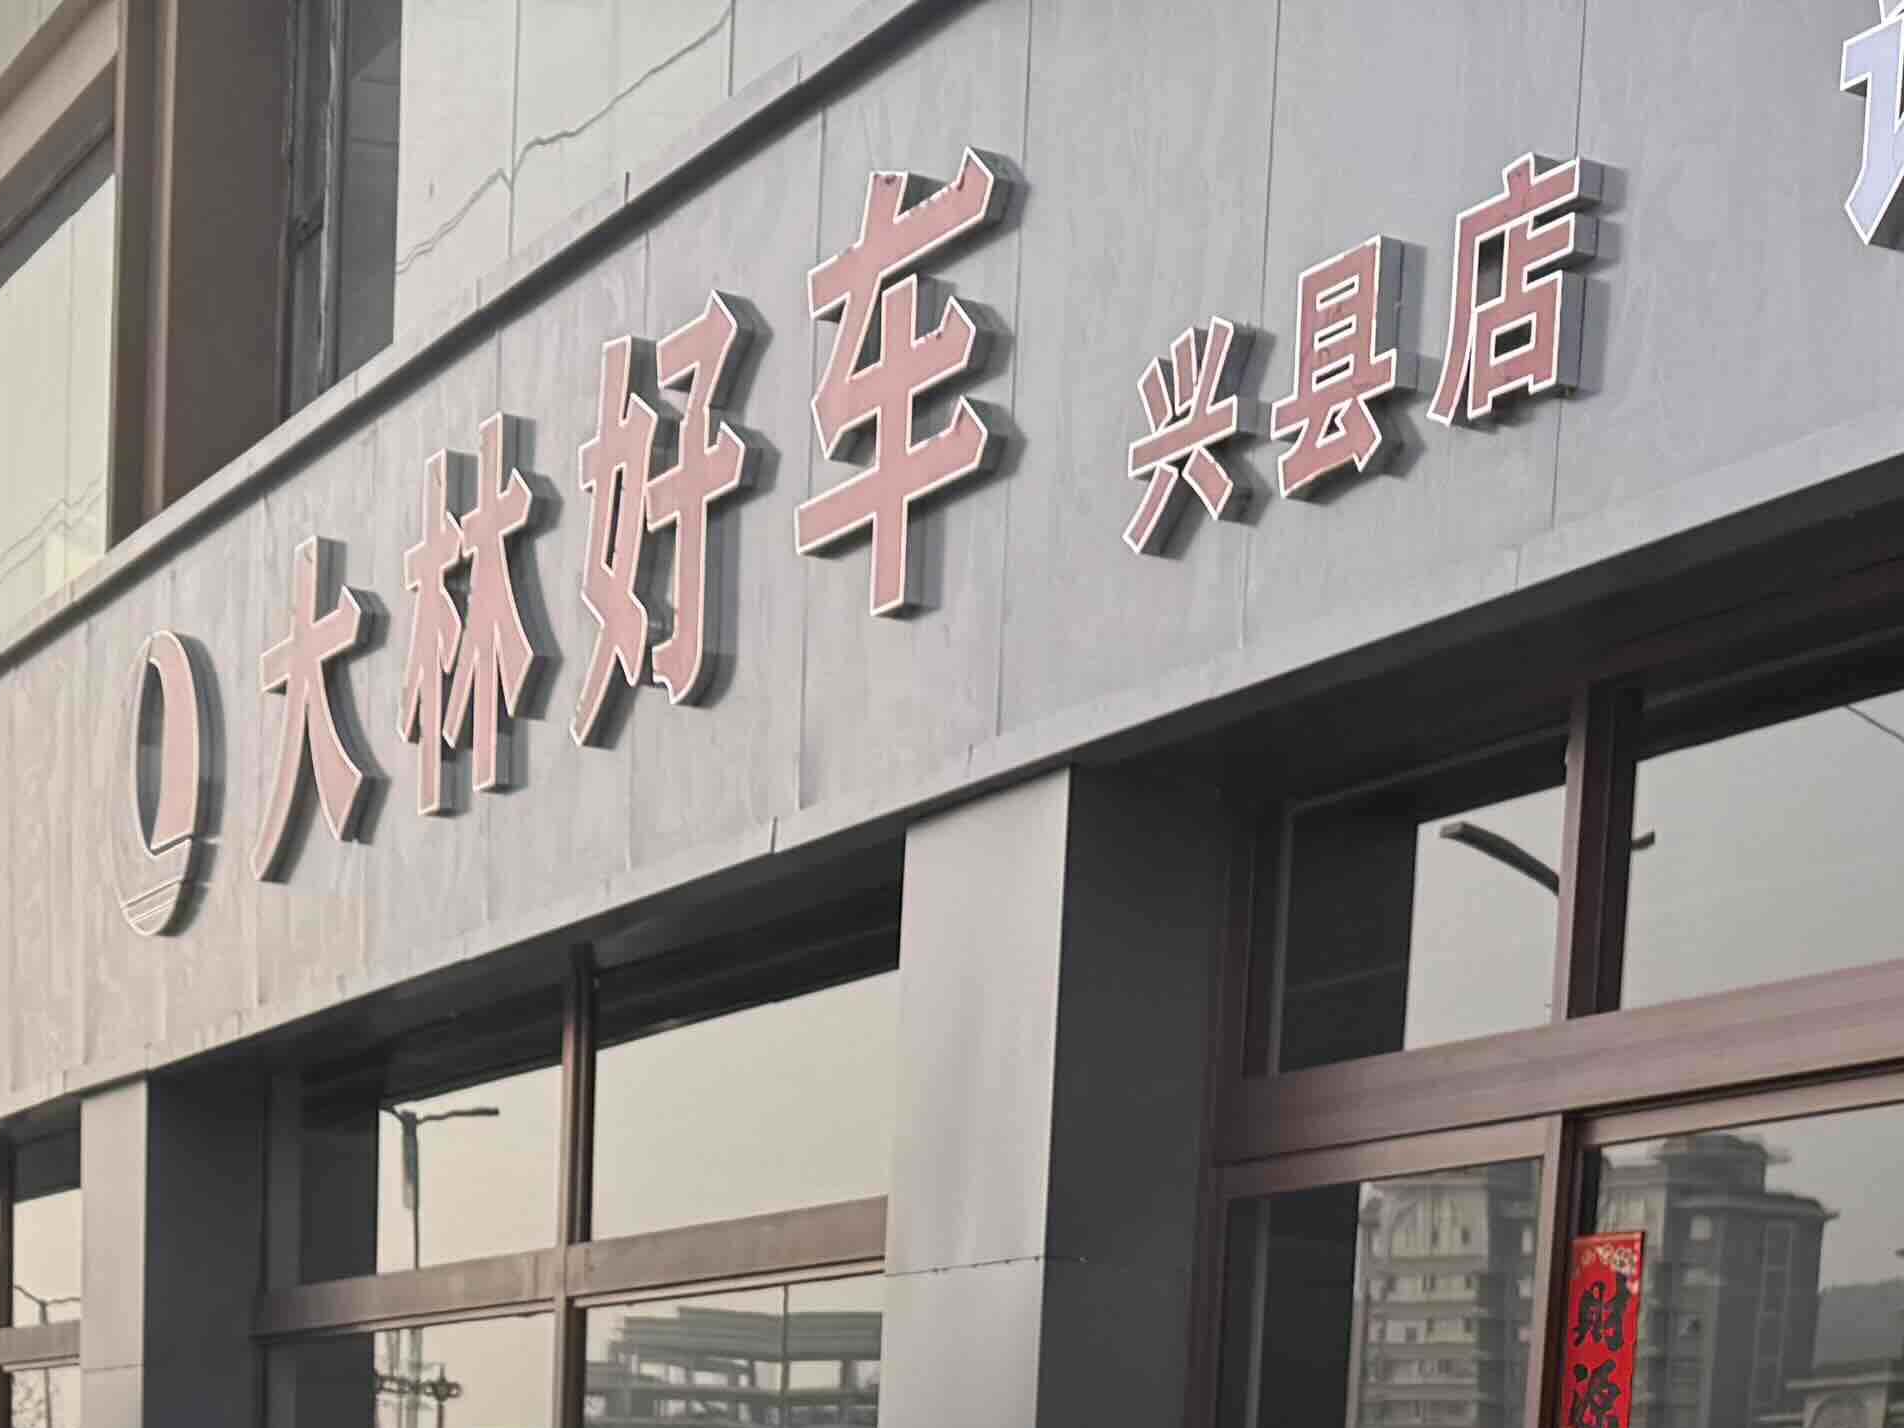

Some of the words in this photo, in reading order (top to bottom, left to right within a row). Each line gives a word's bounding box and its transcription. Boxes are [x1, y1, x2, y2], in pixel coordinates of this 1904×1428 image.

[251, 145, 1008, 885] 大林好车
[1123, 152, 1591, 556] 兴县店
